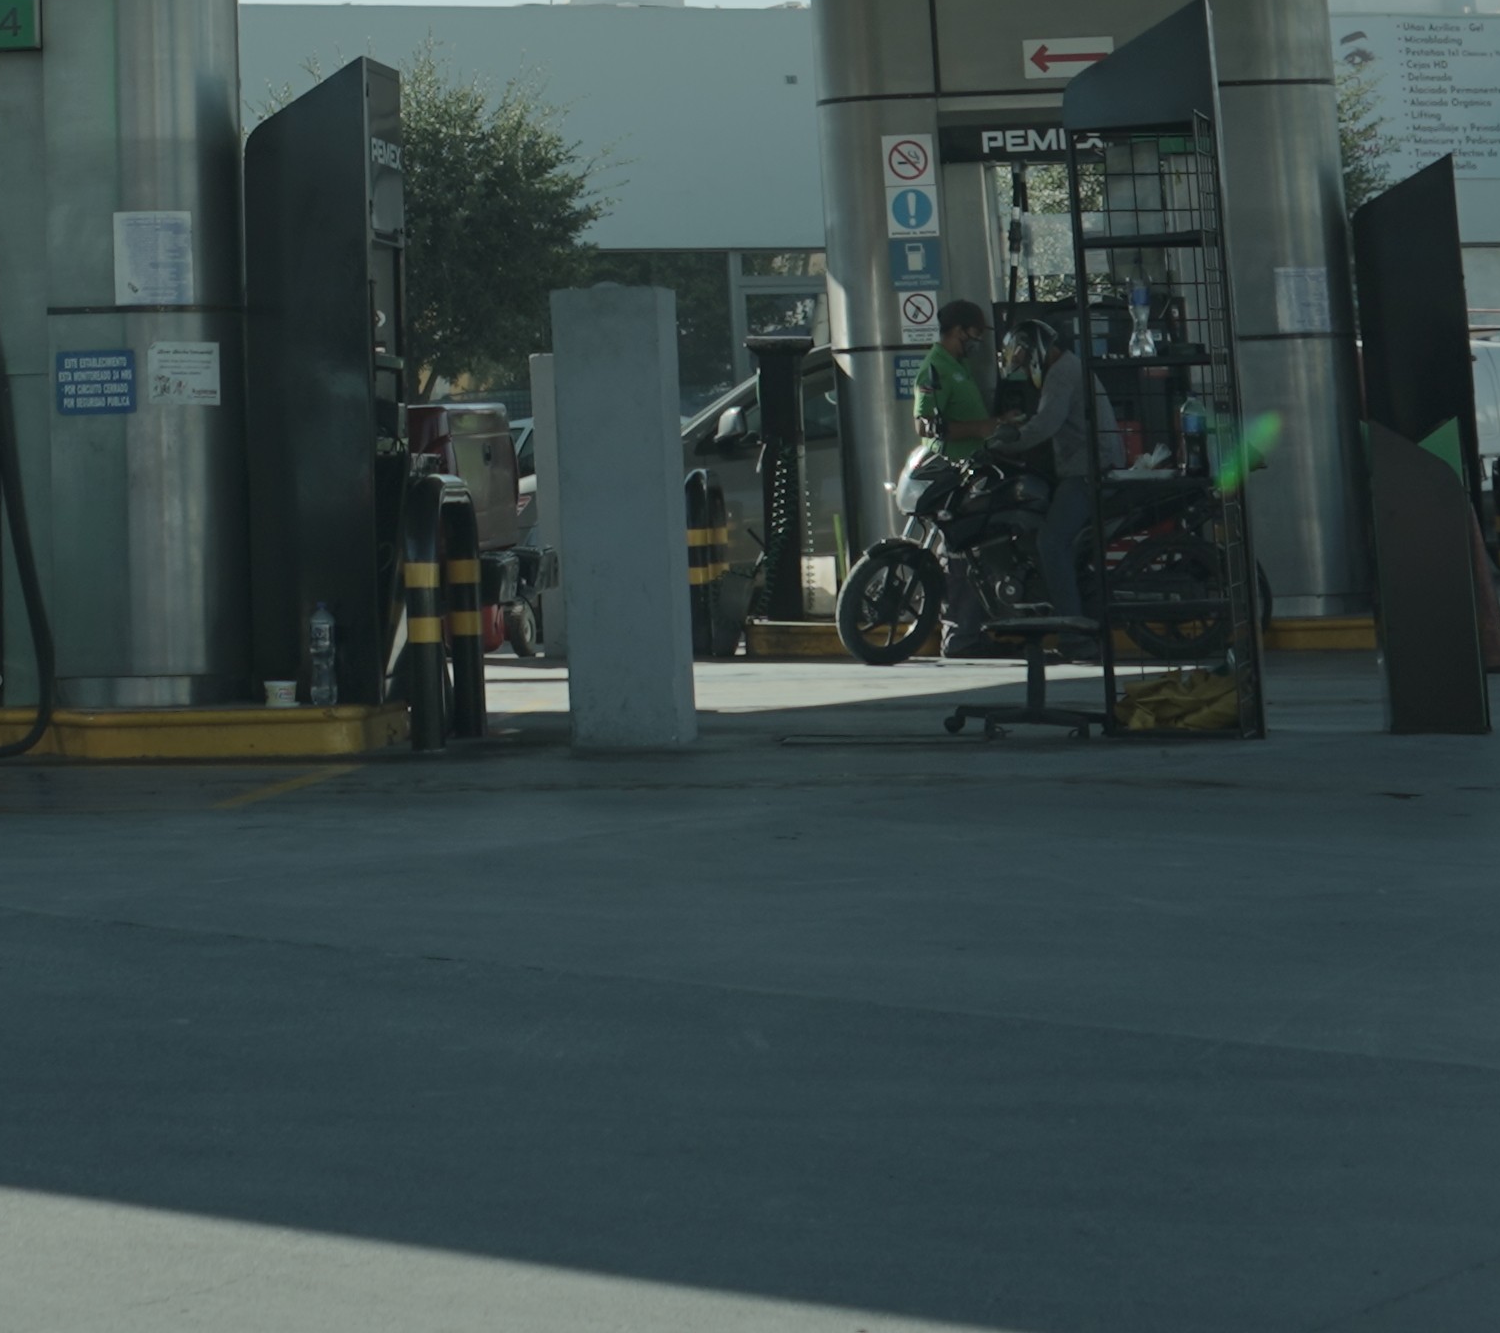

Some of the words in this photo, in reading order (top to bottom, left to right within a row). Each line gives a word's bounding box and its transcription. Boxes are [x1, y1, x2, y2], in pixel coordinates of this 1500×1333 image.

[1404, 35, 1463, 46] Microblading
[1406, 60, 1431, 71] Cejas
[1433, 60, 1449, 70] HD
[1407, 72, 1453, 82] Delineado
[1411, 110, 1442, 121] Lifting
[77, 383, 102, 395] CIRCUITO
